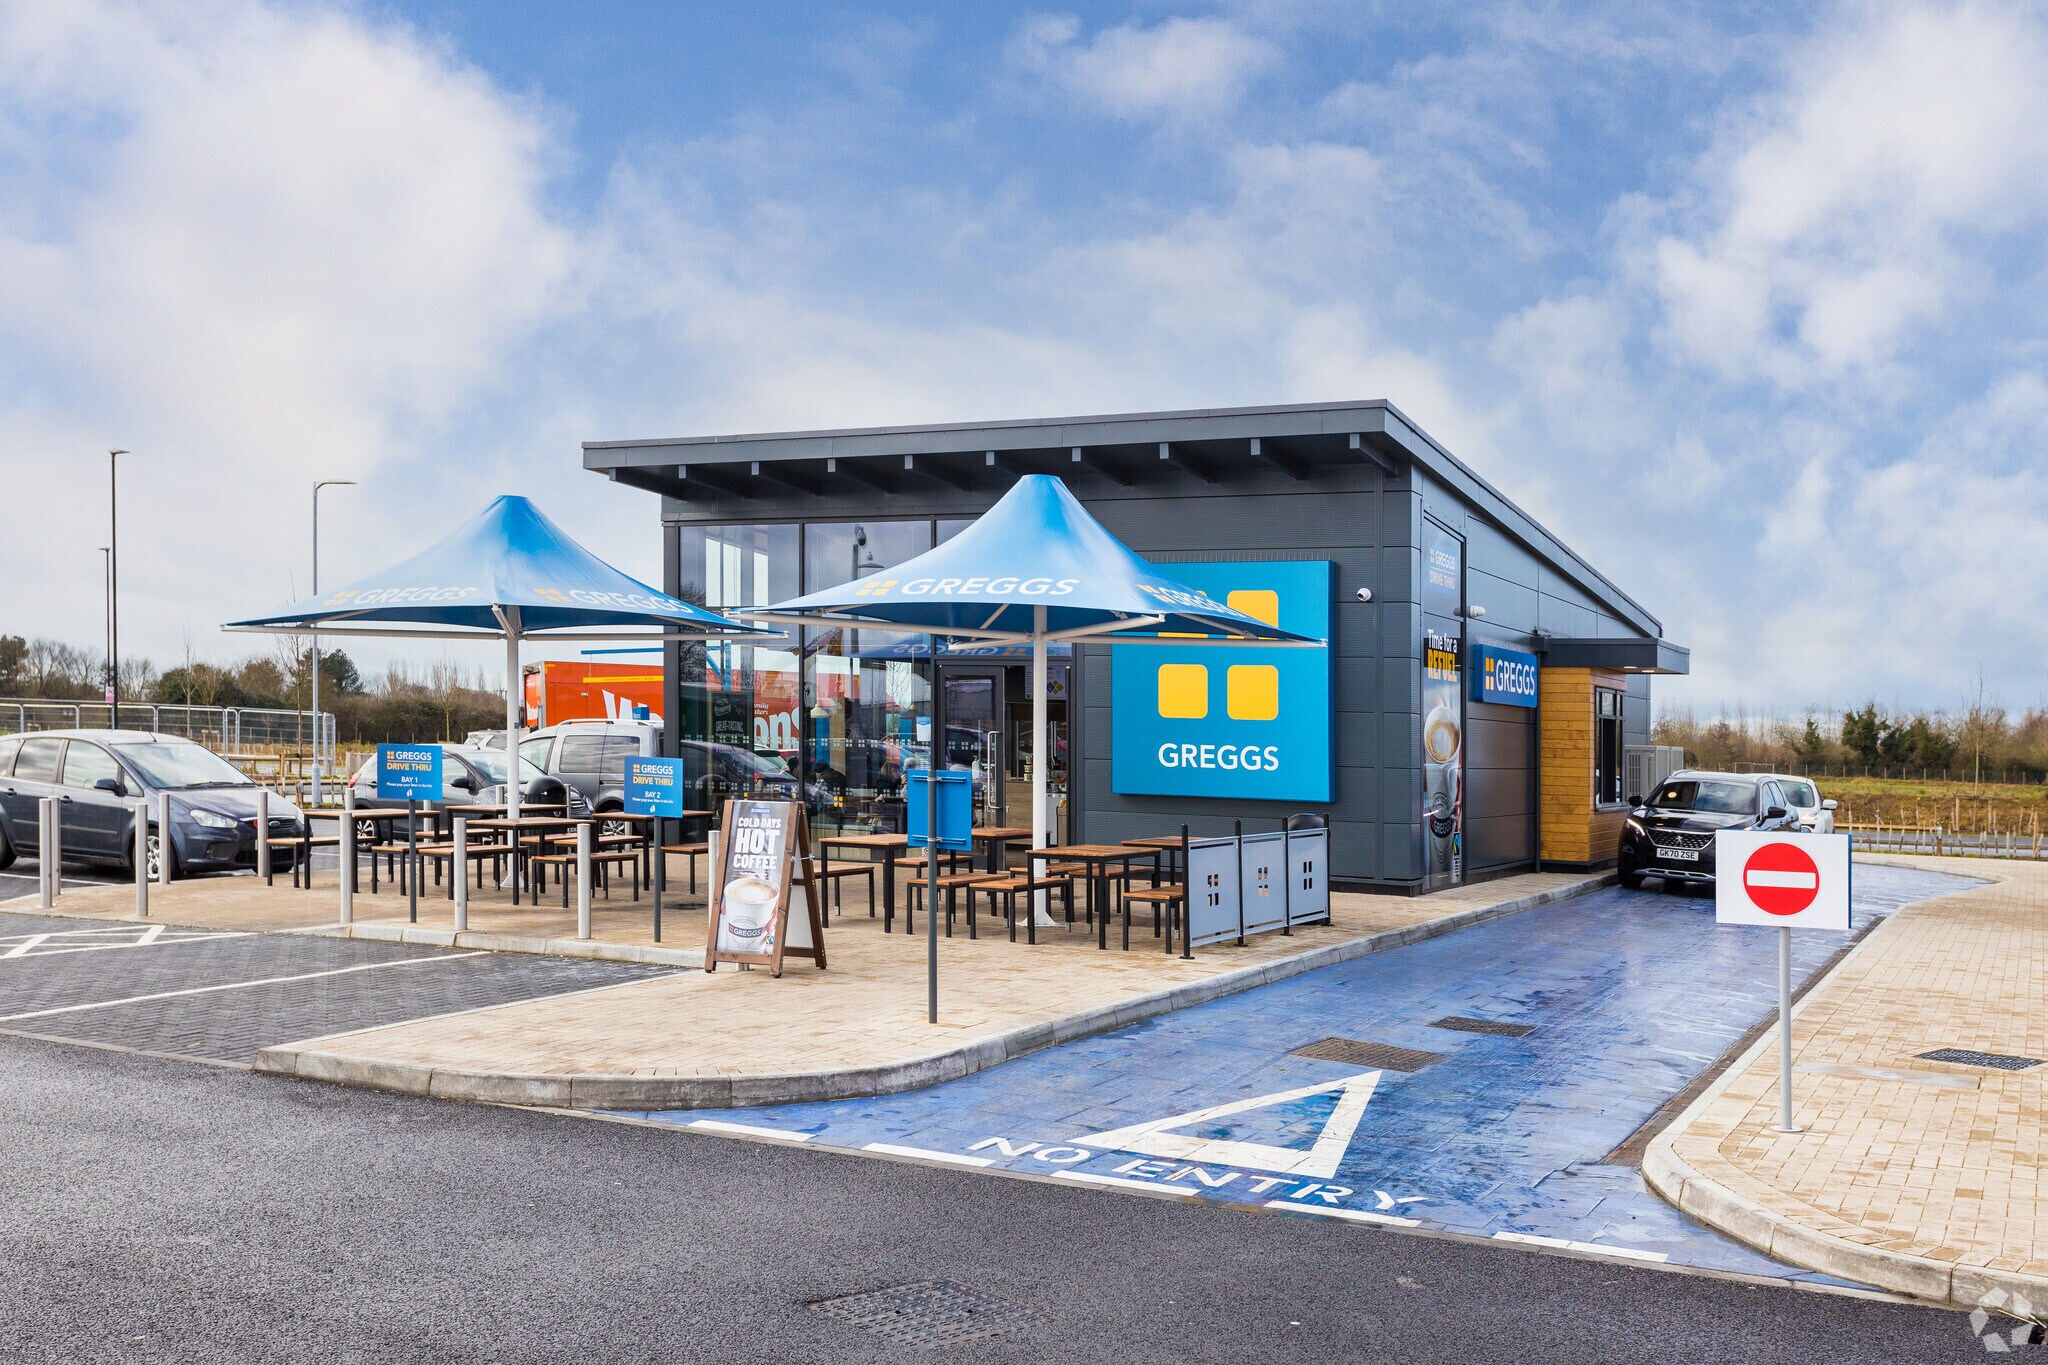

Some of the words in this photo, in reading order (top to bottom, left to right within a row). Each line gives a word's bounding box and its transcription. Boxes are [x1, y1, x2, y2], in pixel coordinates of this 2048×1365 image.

[1435, 550, 1455, 570] GREGGS
[901, 577, 1081, 596] GREGGS
[353, 587, 478, 605] GREGGS
[569, 589, 694, 614] GREGGS
[1428, 628, 1443, 651] Time
[1444, 633, 1453, 652] for
[1453, 639, 1458, 653] a
[1427, 648, 1458, 683] REFUEL
[1495, 659, 1535, 696] GREGGS
[396, 751, 432, 761] GREGGS
[1158, 742, 1280, 772] GREGGS
[387, 762, 410, 771] DRIVE
[411, 763, 432, 772] THRU
[641, 764, 674, 775] GREGGS
[633, 776, 653, 785] DRIVE
[655, 777, 674, 787] THRU
[738, 817, 760, 828] COLD
[761, 818, 782, 829] DAYS
[735, 827, 780, 855] HOT
[733, 854, 777, 870] COFFEE
[1659, 849, 1679, 858] GK70
[1680, 851, 1696, 860] ZSE
[733, 928, 761, 937] GREGGS
[967, 1137, 1091, 1163] NO
[1112, 1160, 1428, 1210] ENTRY
